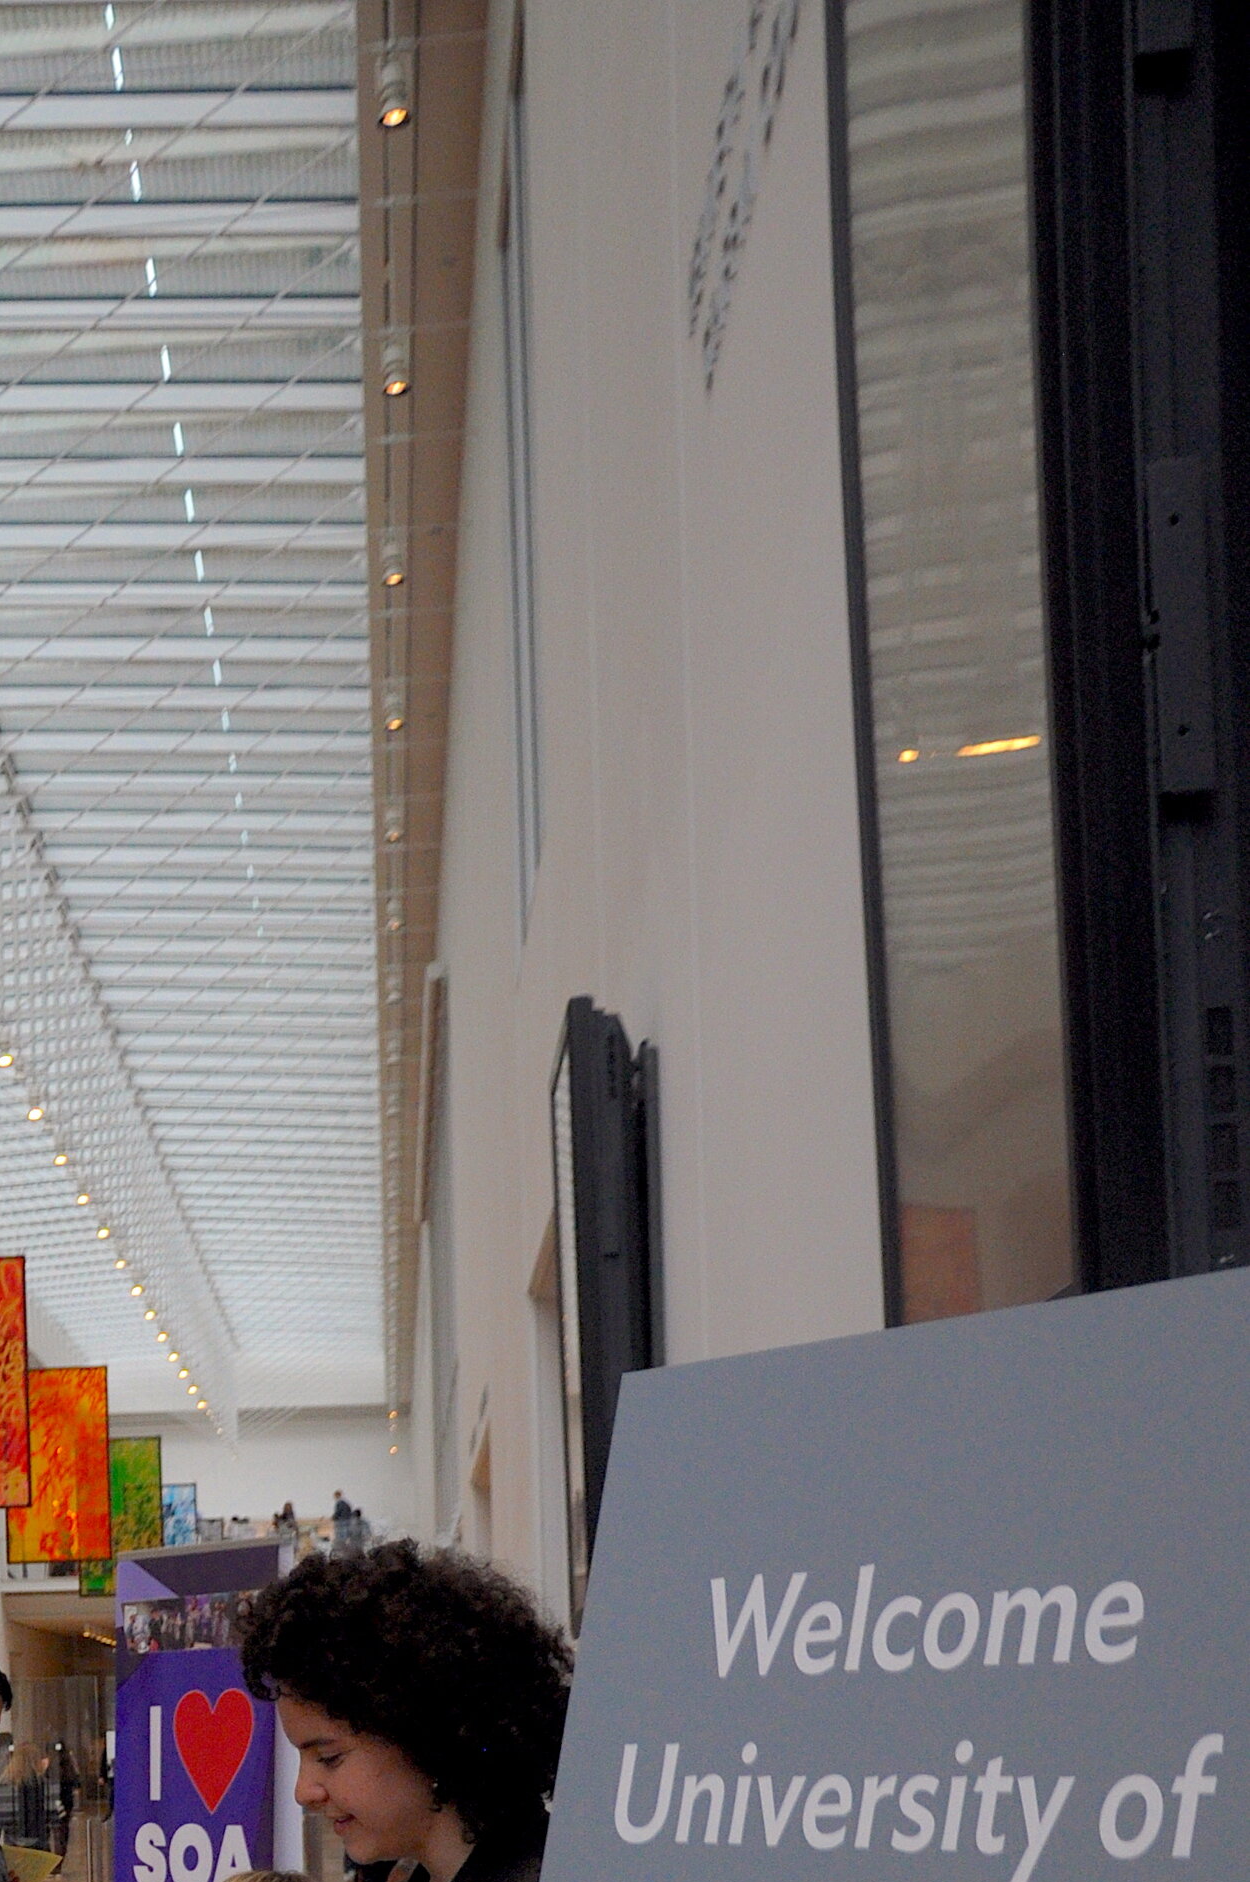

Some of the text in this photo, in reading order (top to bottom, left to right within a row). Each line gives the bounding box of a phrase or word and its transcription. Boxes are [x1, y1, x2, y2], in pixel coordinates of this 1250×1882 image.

[710, 1563, 1145, 1678] Welcome
[150, 1705, 162, 1801] I
[1099, 1733, 1224, 1860] of
